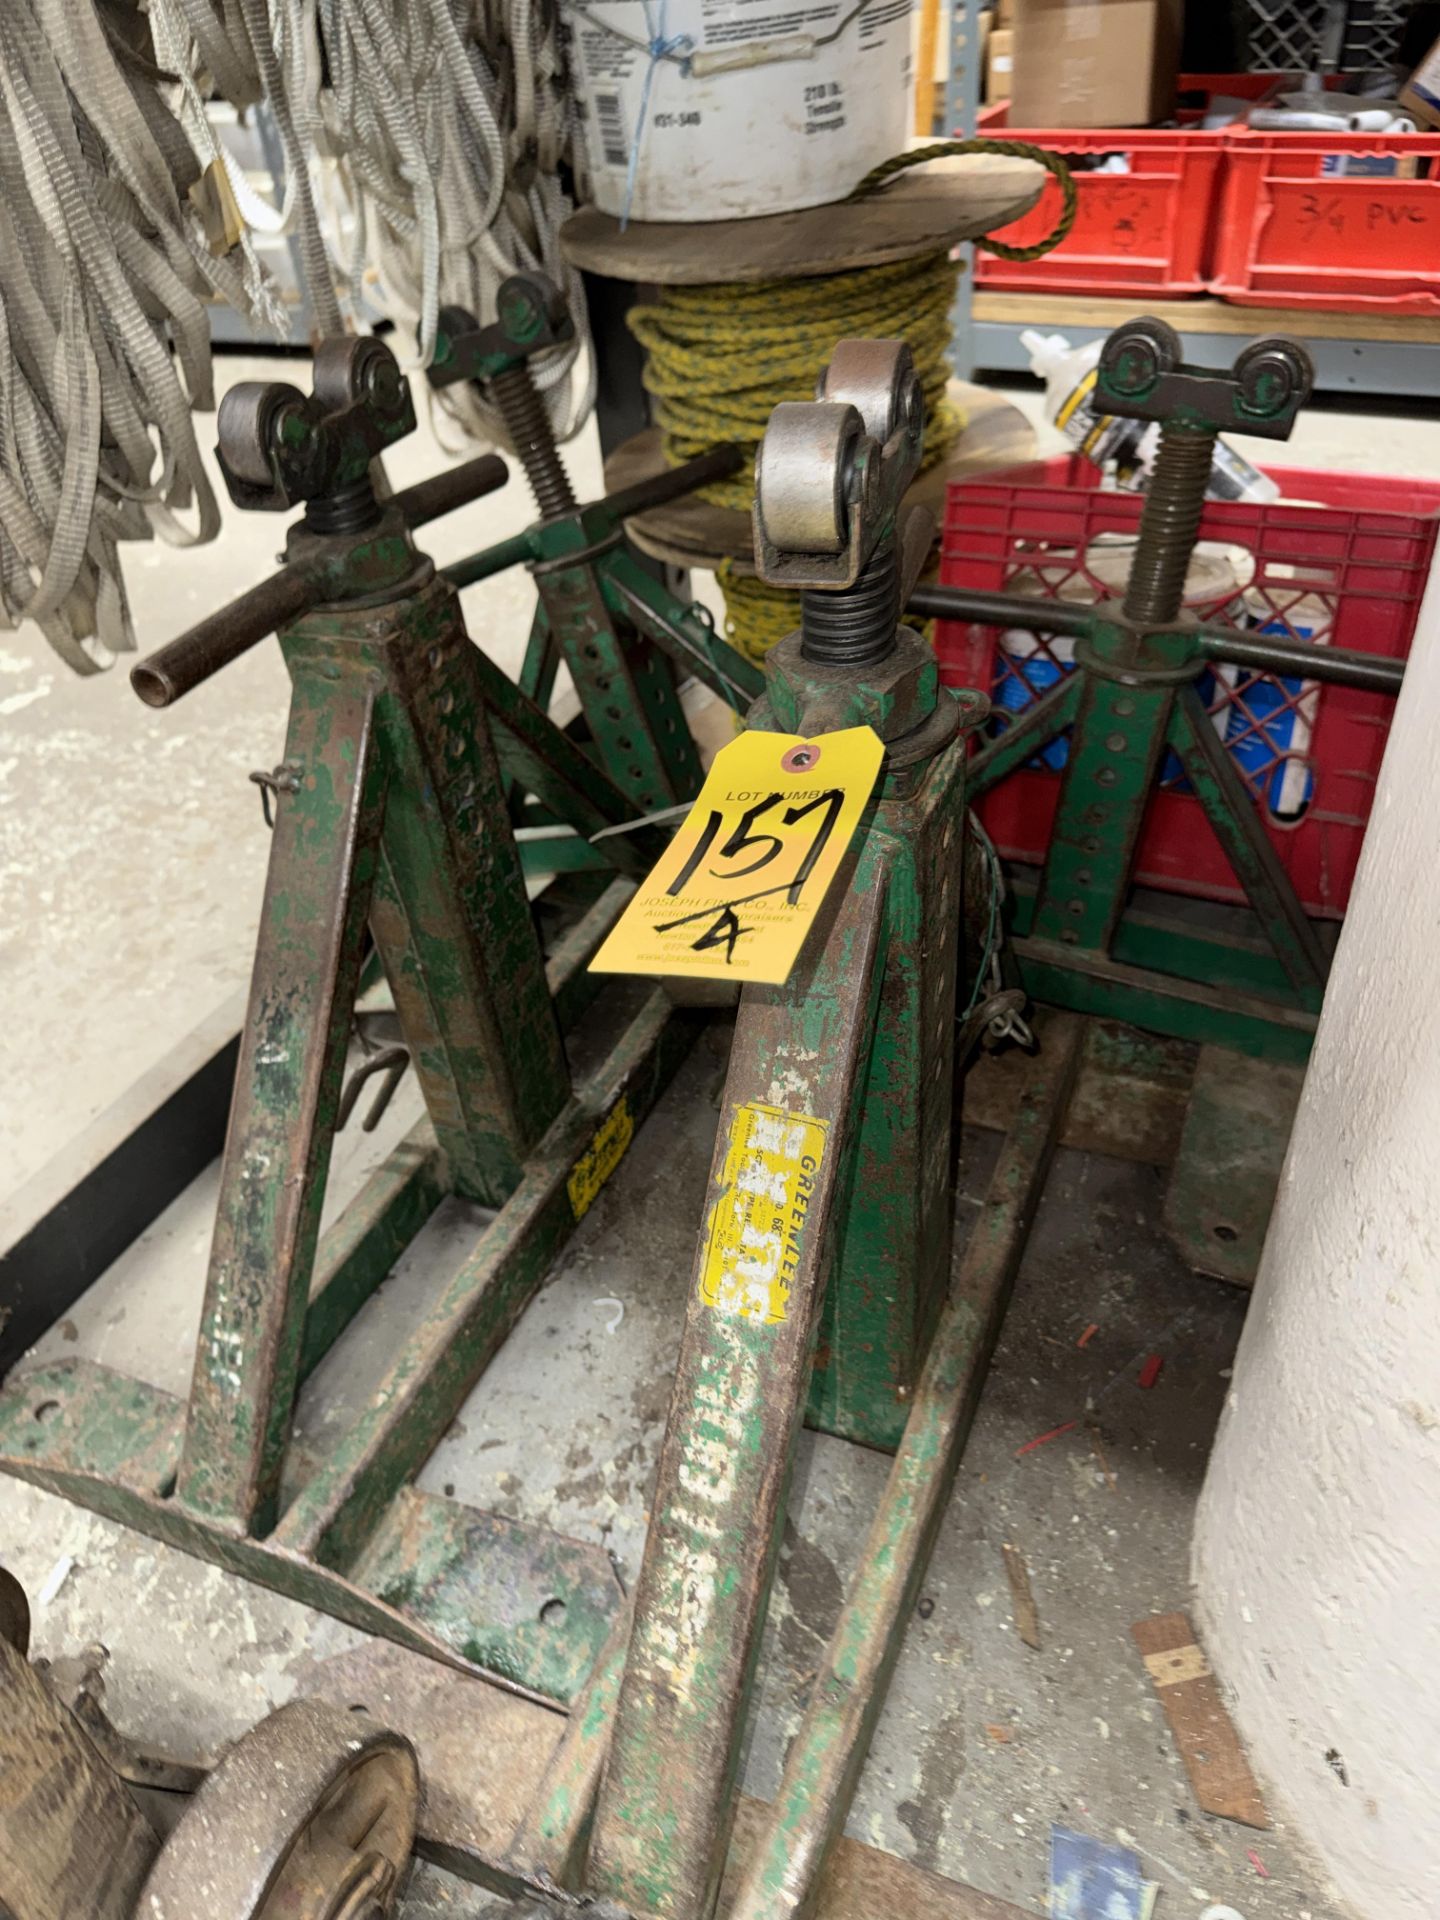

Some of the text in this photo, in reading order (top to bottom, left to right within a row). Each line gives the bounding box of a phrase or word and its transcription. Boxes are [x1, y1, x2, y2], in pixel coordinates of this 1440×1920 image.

[1366, 202, 1428, 231] PVC
[725, 791, 763, 801] LOT
[665, 787, 846, 906] 157
[640, 896, 700, 908] JOSEPH
